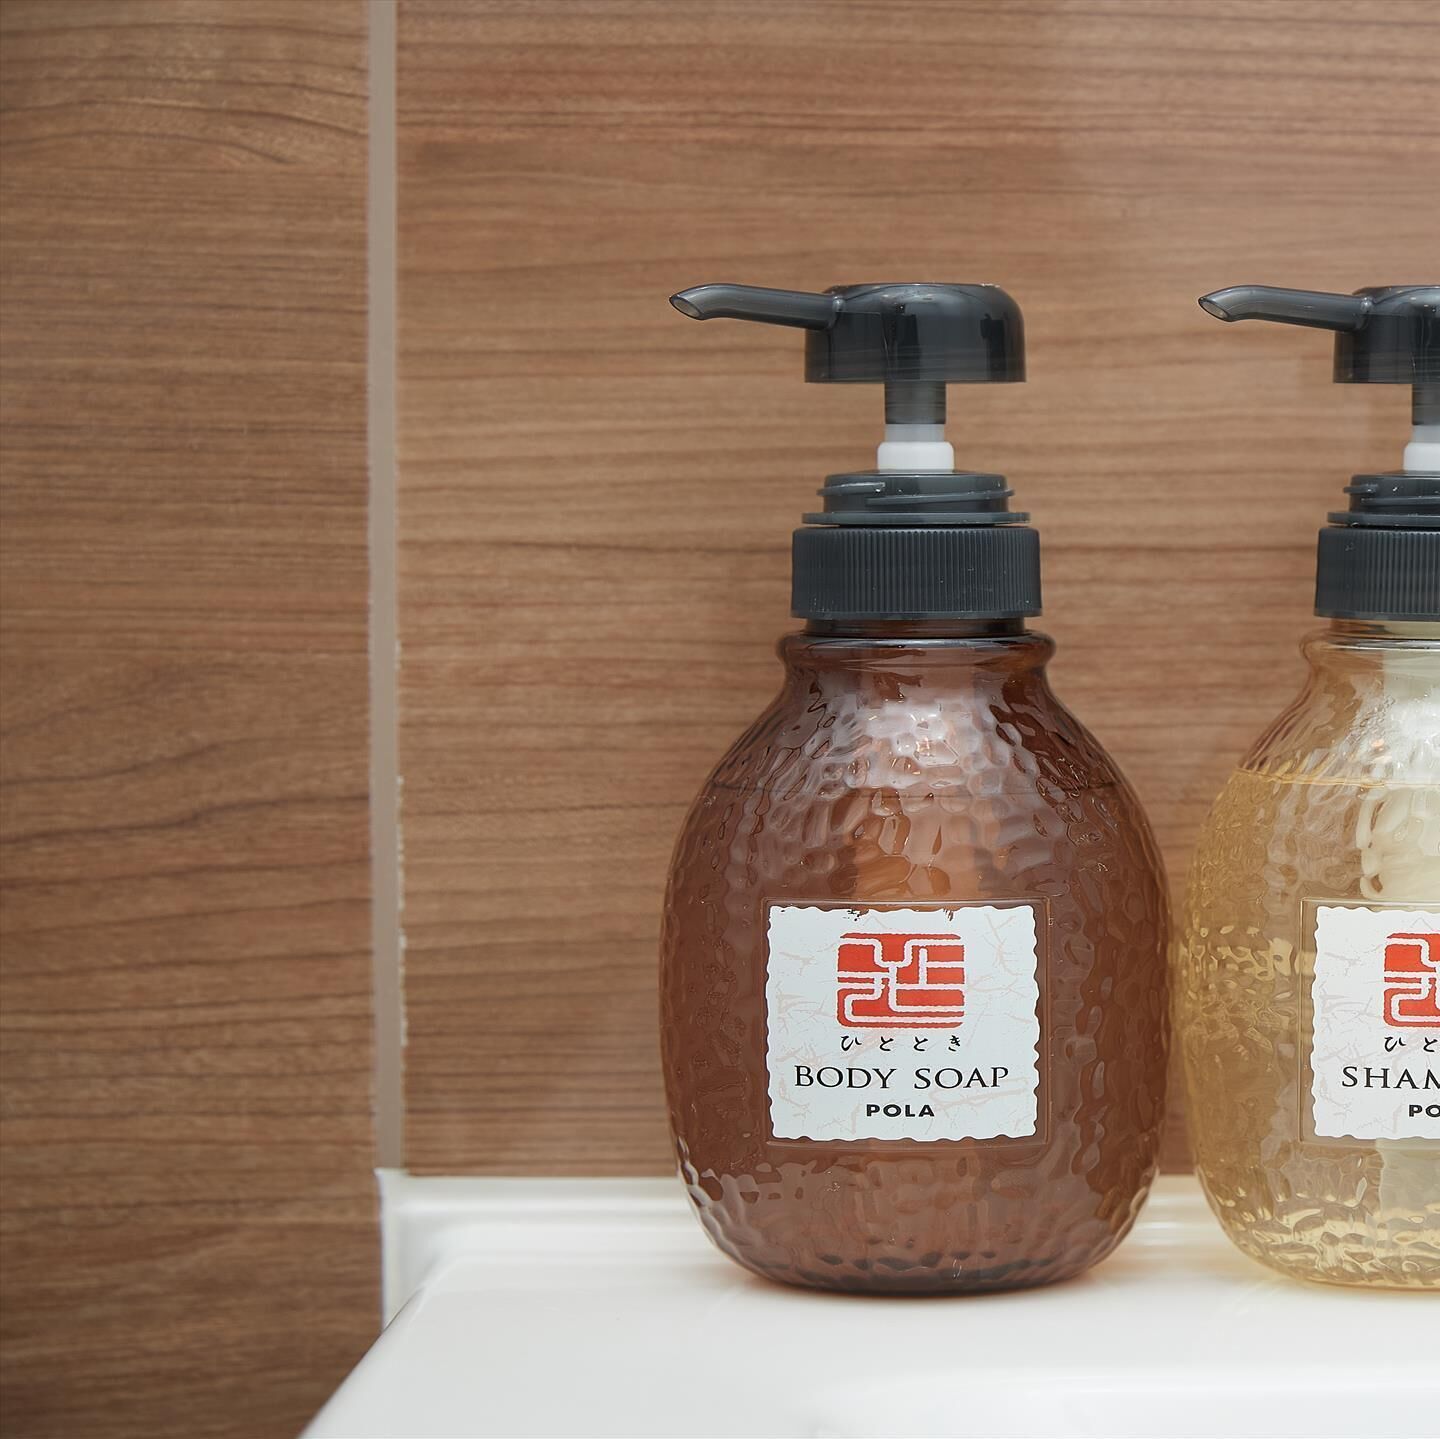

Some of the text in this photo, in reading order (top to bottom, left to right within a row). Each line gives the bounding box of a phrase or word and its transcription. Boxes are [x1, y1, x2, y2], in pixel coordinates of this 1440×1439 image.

[840, 1034, 961, 1052] ひととき
[794, 1064, 1009, 1090] BODY SOAP
[866, 1103, 935, 1118] POLA
